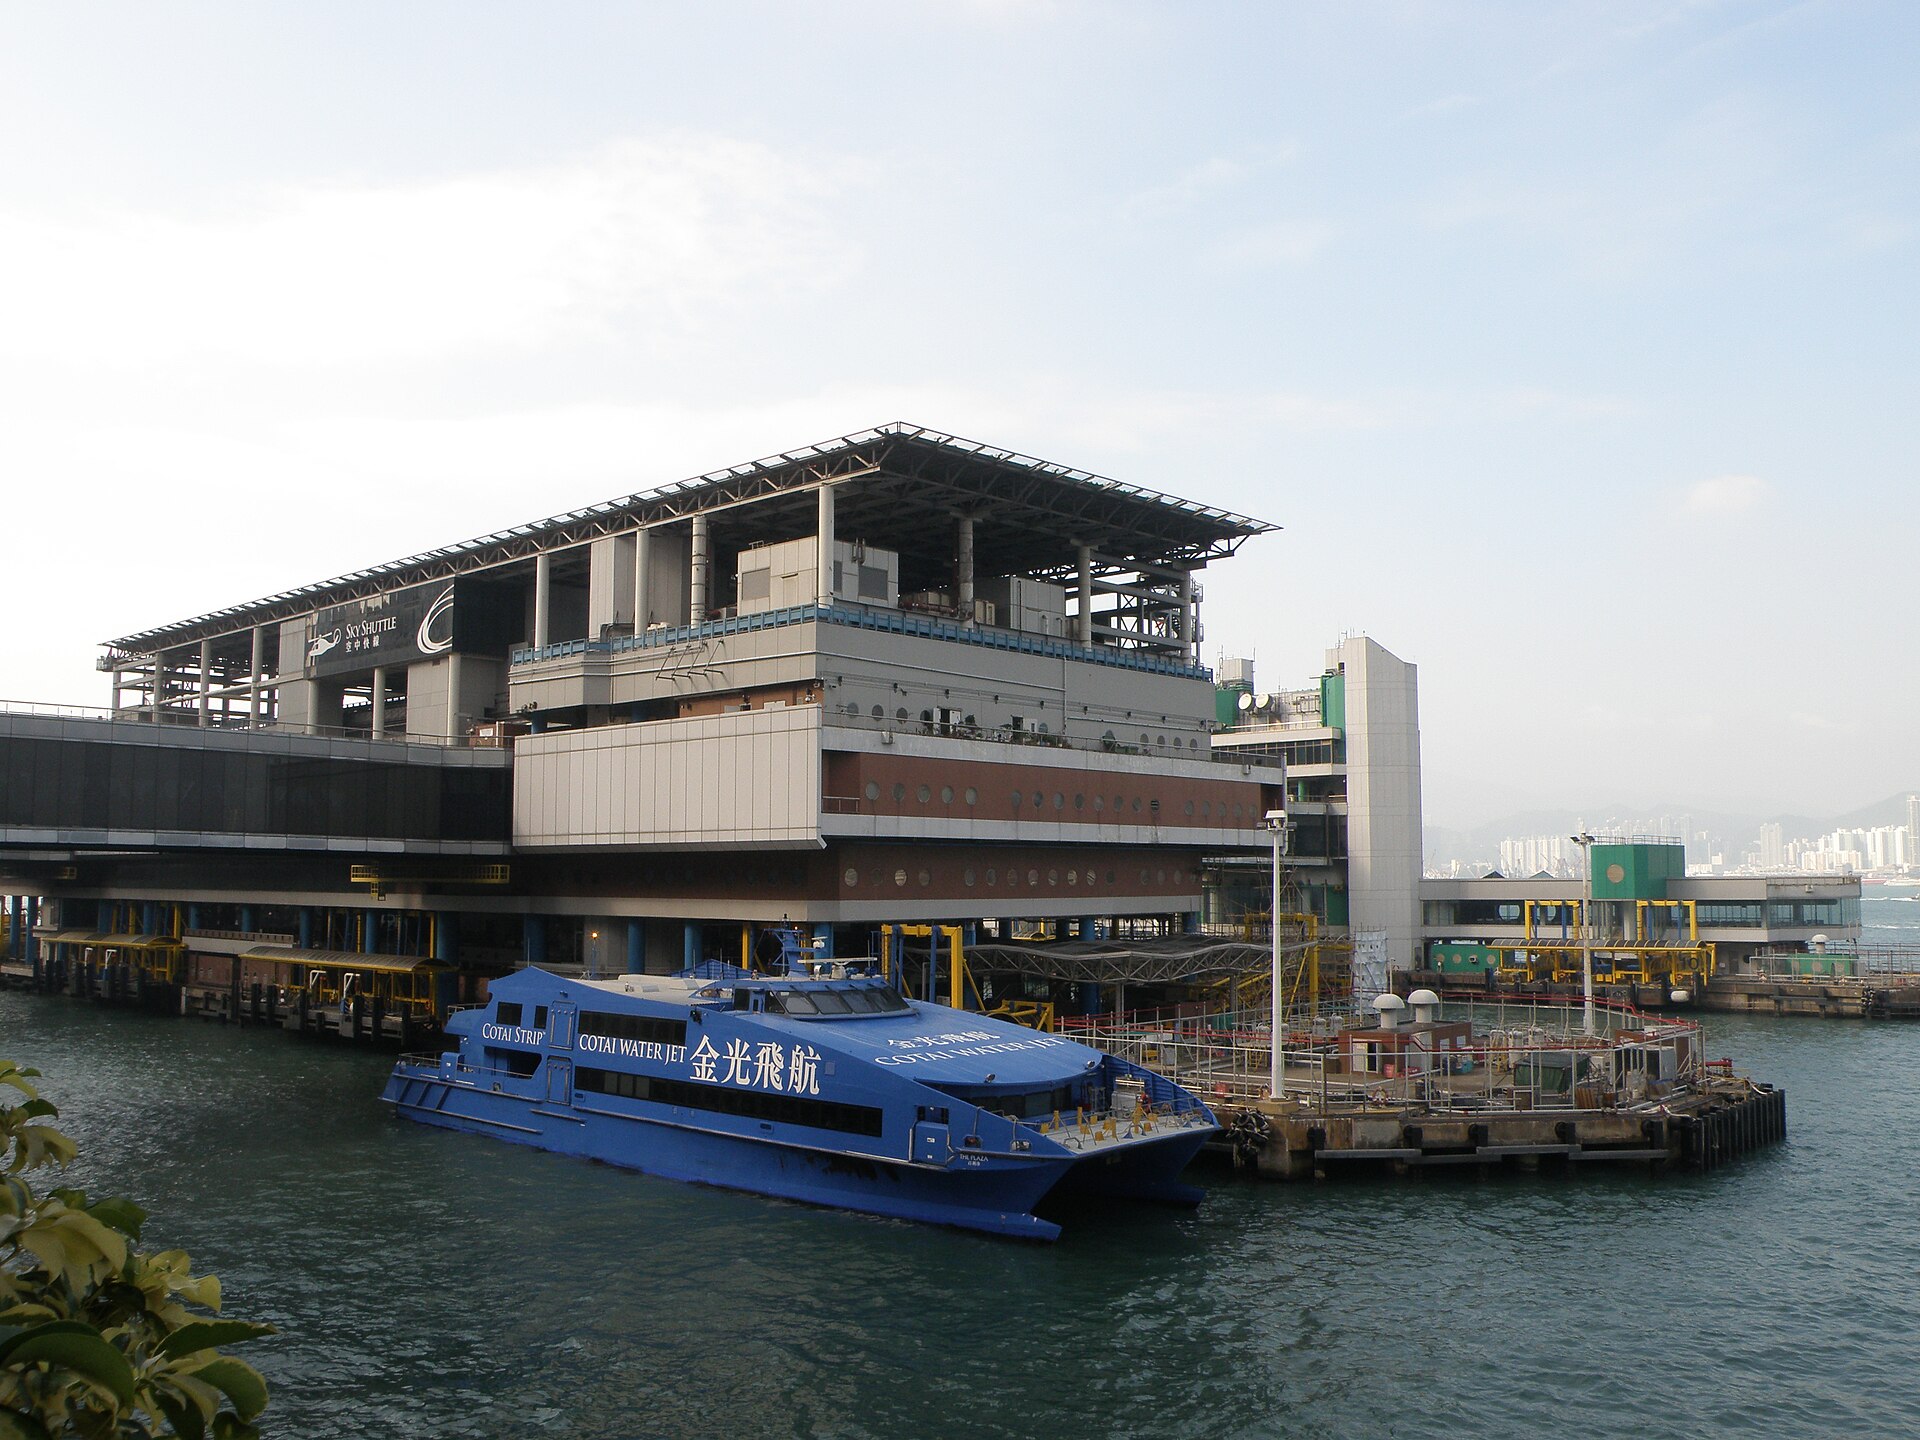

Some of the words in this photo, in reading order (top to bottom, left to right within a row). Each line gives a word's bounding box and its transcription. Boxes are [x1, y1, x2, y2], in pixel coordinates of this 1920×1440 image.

[346, 623, 361, 639] SKY
[361, 616, 397, 635] SHUTTLE
[482, 1022, 513, 1041] COTAI
[887, 1030, 1000, 1049] 金光飛航
[579, 1033, 617, 1052] COTAI
[618, 1038, 663, 1060] WATER
[664, 1043, 688, 1066] JET
[874, 1049, 956, 1067] COTAI
[950, 1041, 1031, 1057] WATER
[1030, 1036, 1065, 1050] JET
[689, 1034, 822, 1095] 金光飛航
